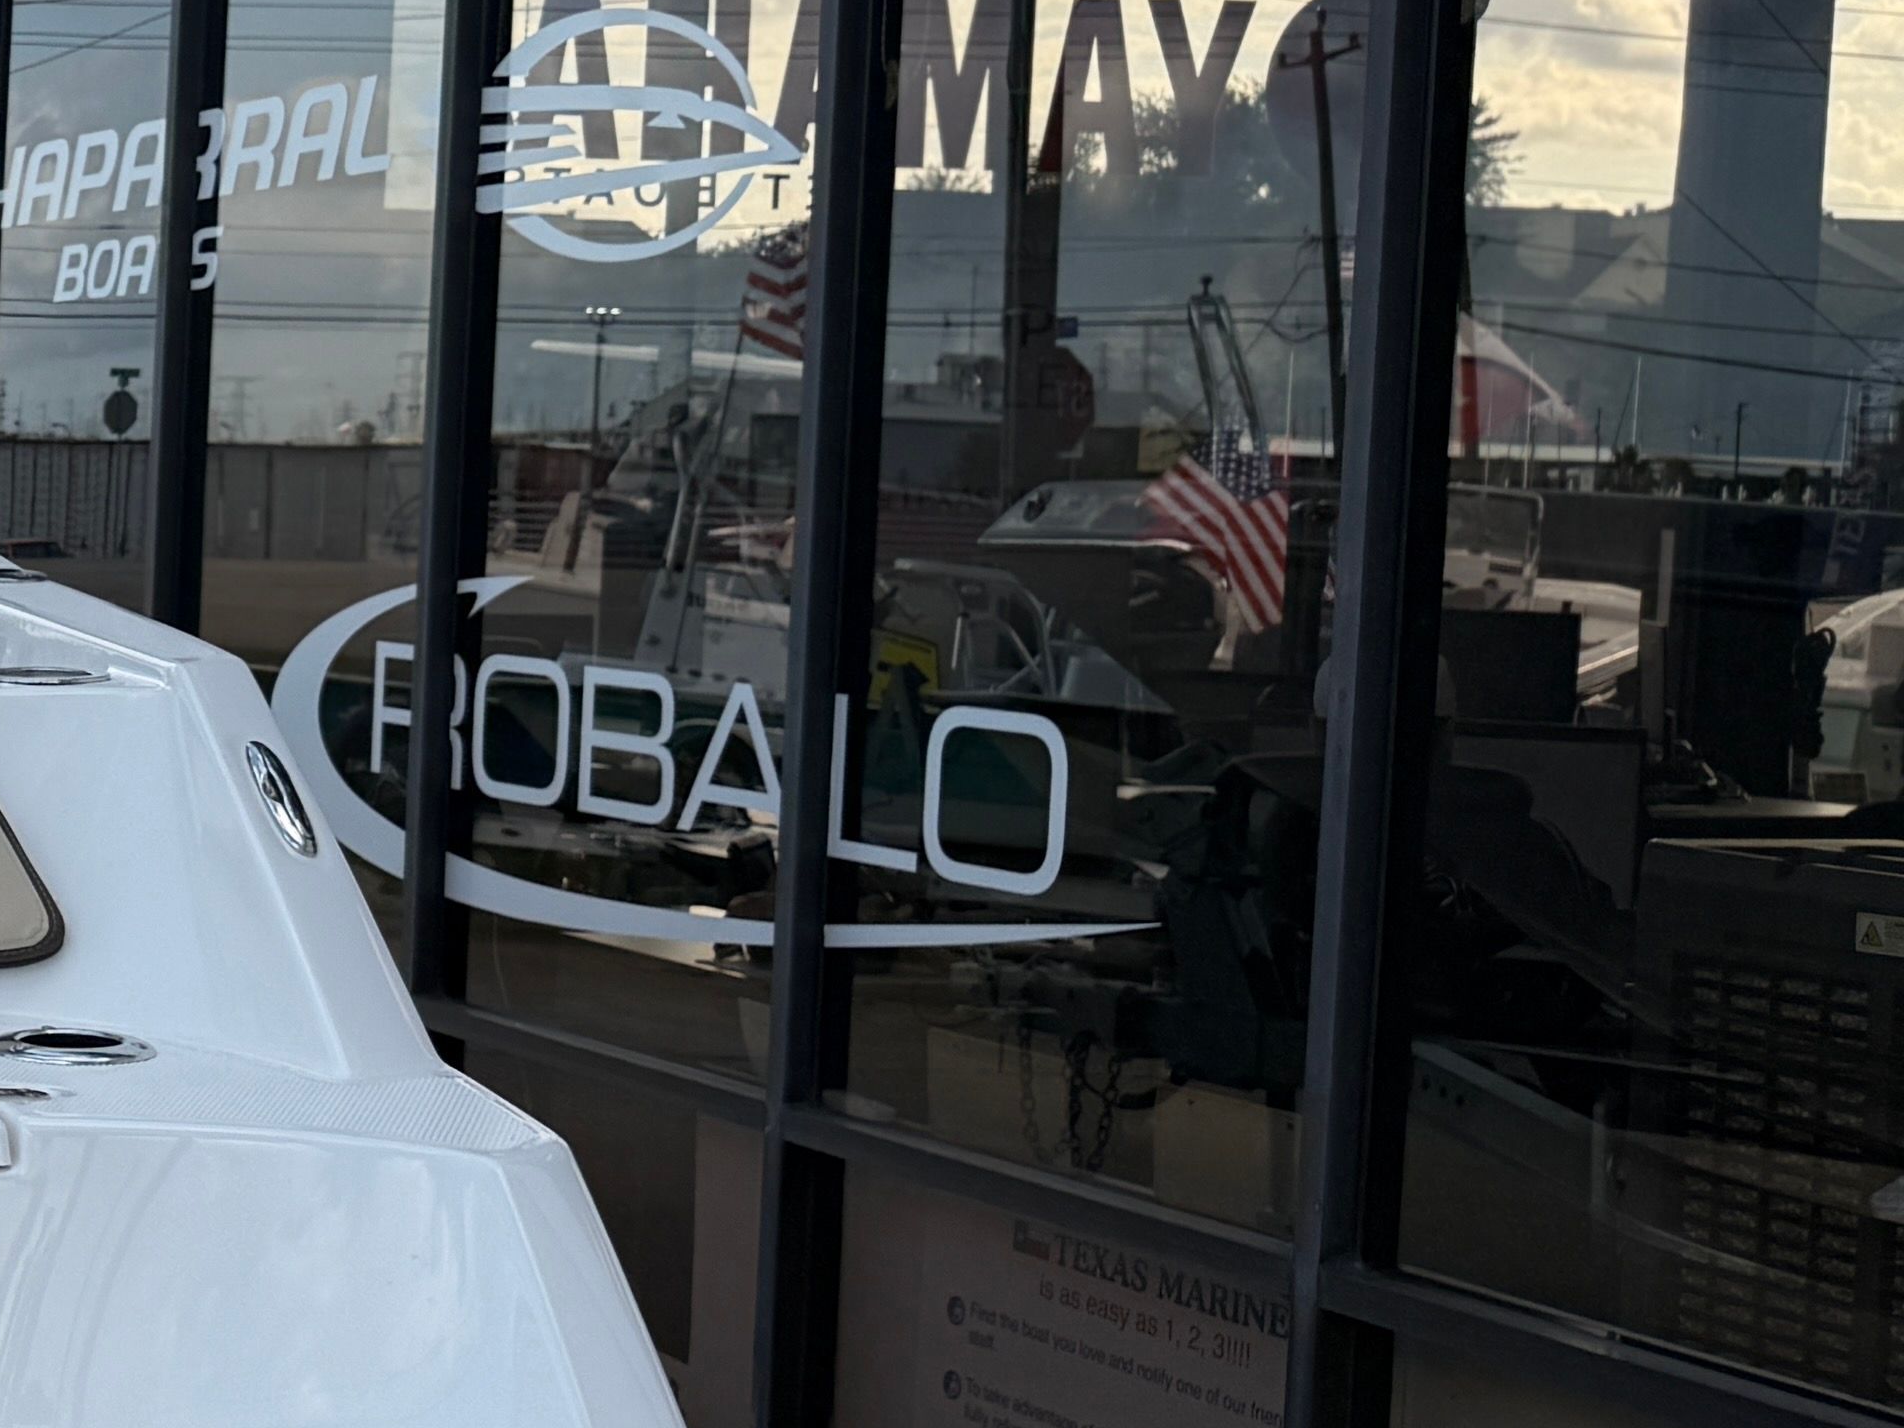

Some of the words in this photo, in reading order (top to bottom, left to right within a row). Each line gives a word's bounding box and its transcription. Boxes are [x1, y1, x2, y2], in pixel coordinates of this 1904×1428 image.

[52, 226, 224, 302] BOAS
[368, 638, 1071, 899] ROBALO
[1040, 1279, 1054, 1301] is
[1059, 1287, 1081, 1310] as
[1086, 1295, 1130, 1331] easy
[1135, 1311, 1158, 1337] as
[1055, 1233, 1149, 1293] TEXAS
[1157, 1266, 1290, 1340] MARINE
